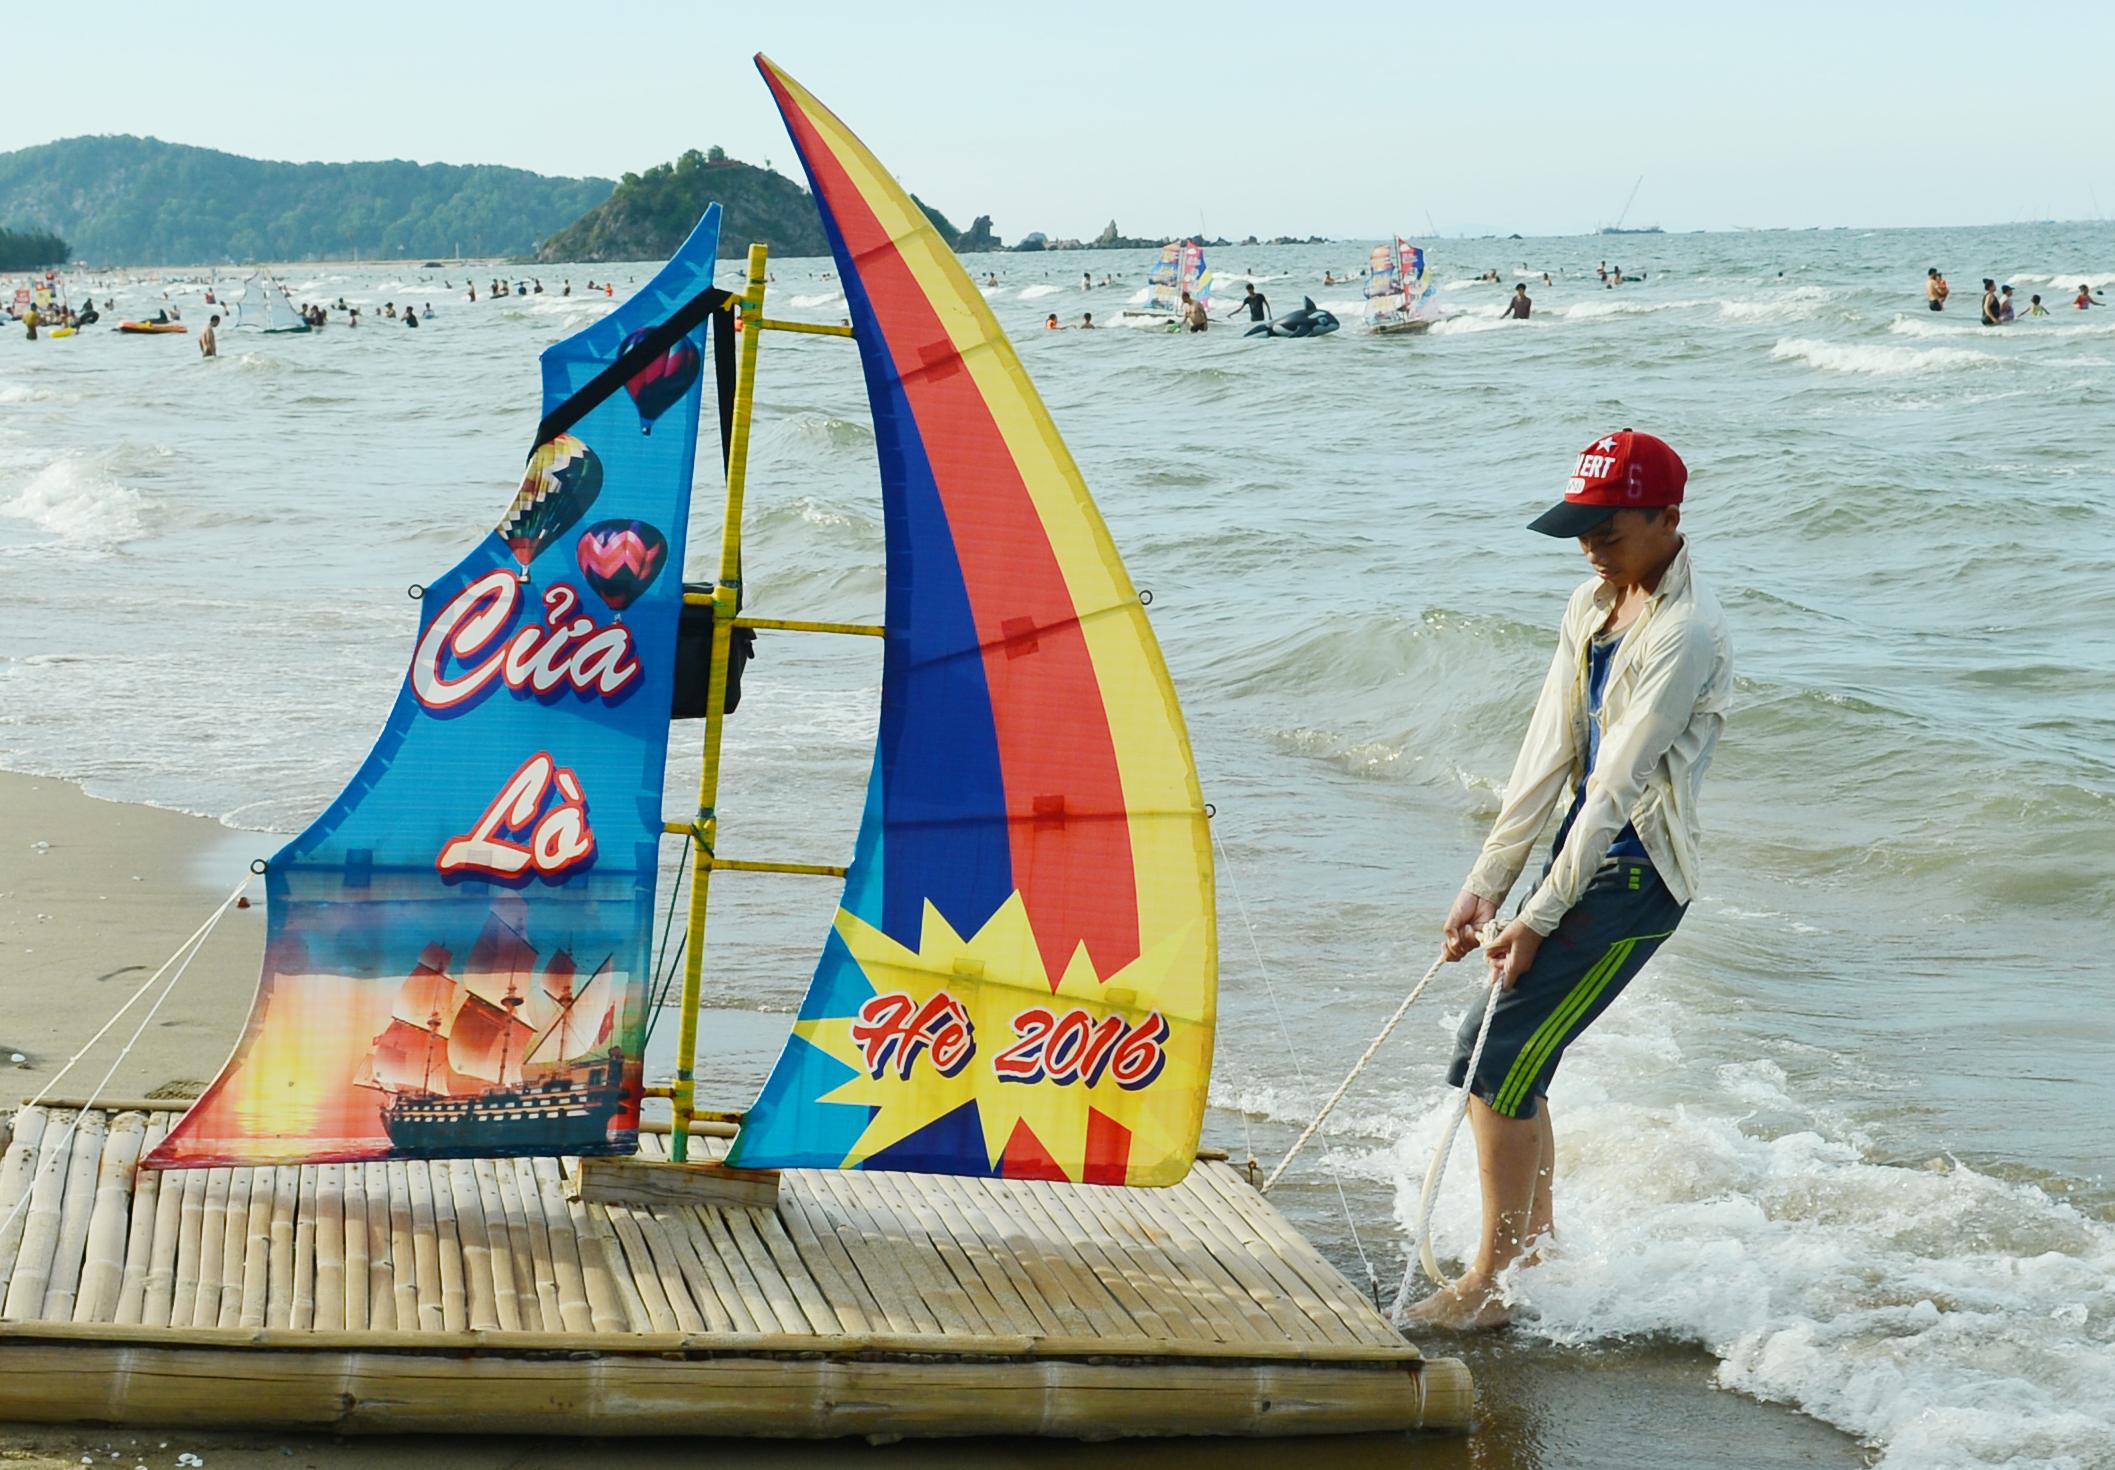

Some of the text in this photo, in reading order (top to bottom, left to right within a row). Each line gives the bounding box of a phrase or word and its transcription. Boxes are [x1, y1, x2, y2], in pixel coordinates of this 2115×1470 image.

[410, 568, 642, 712] Cửa
[436, 751, 596, 882] Lò
[851, 990, 1168, 1089] Hè 2016
